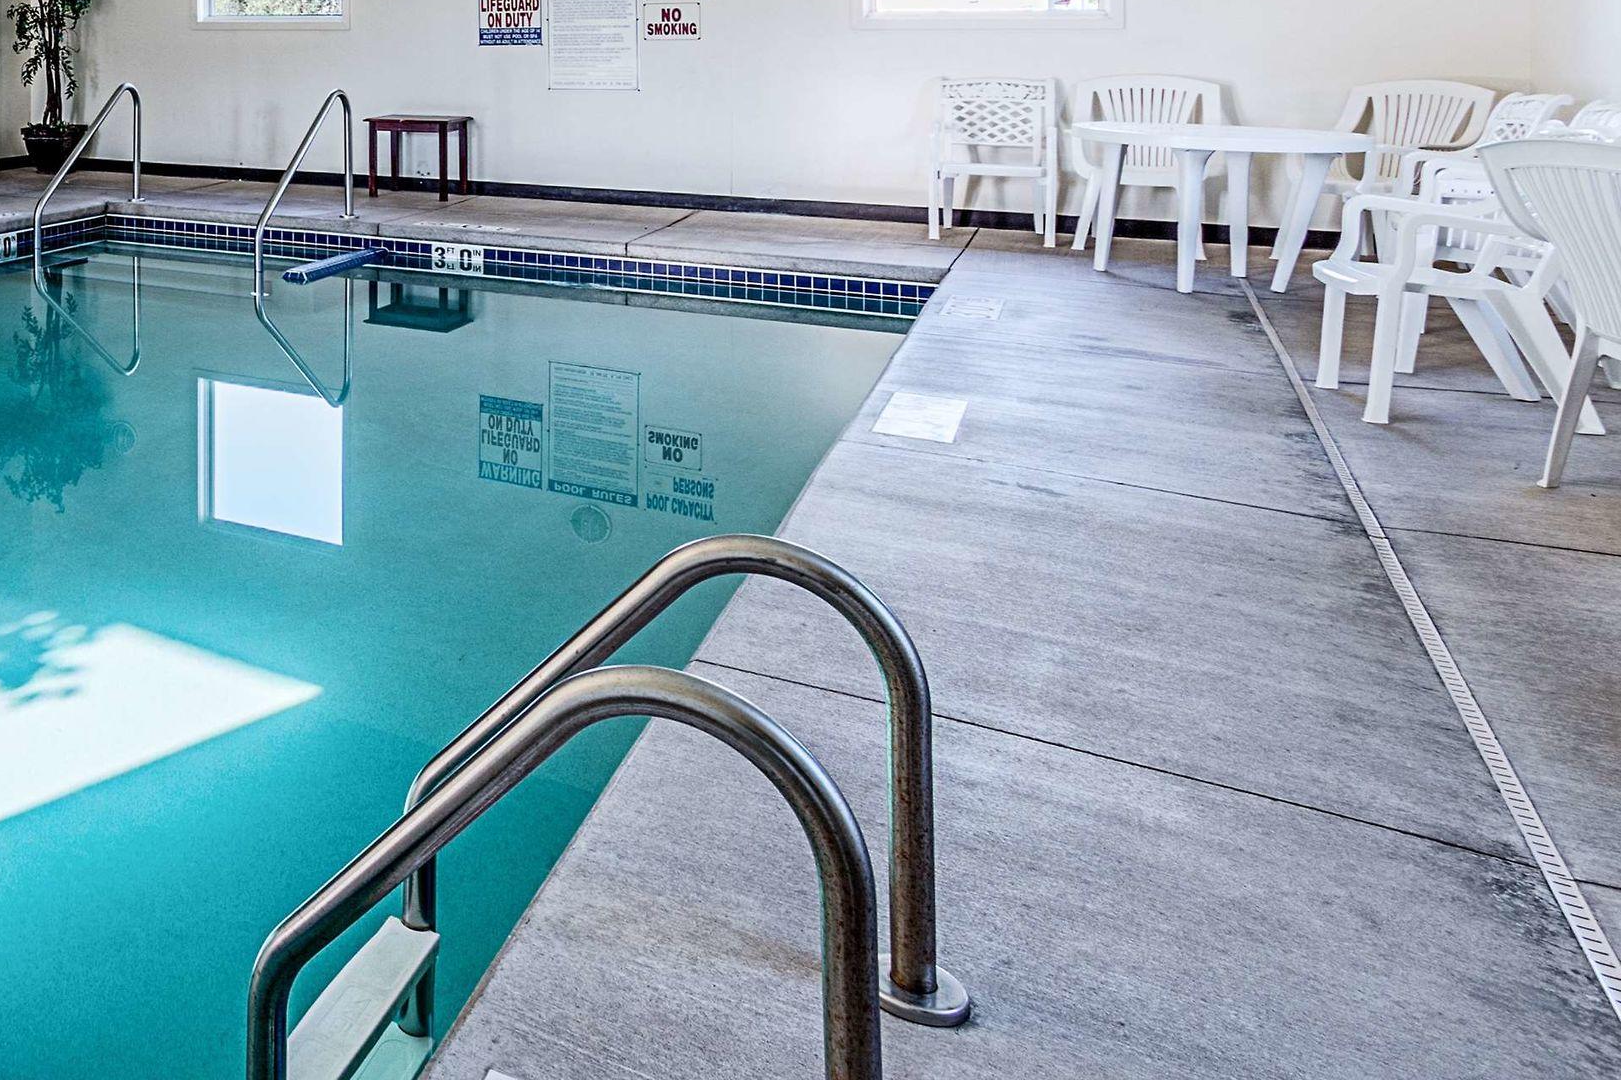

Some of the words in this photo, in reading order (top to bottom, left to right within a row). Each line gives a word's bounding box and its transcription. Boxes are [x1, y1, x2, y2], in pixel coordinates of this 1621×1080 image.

[487, 13, 502, 27] ON
[505, 12, 533, 27] DUTY
[661, 8, 682, 22] NO
[647, 23, 697, 36] SMOKING
